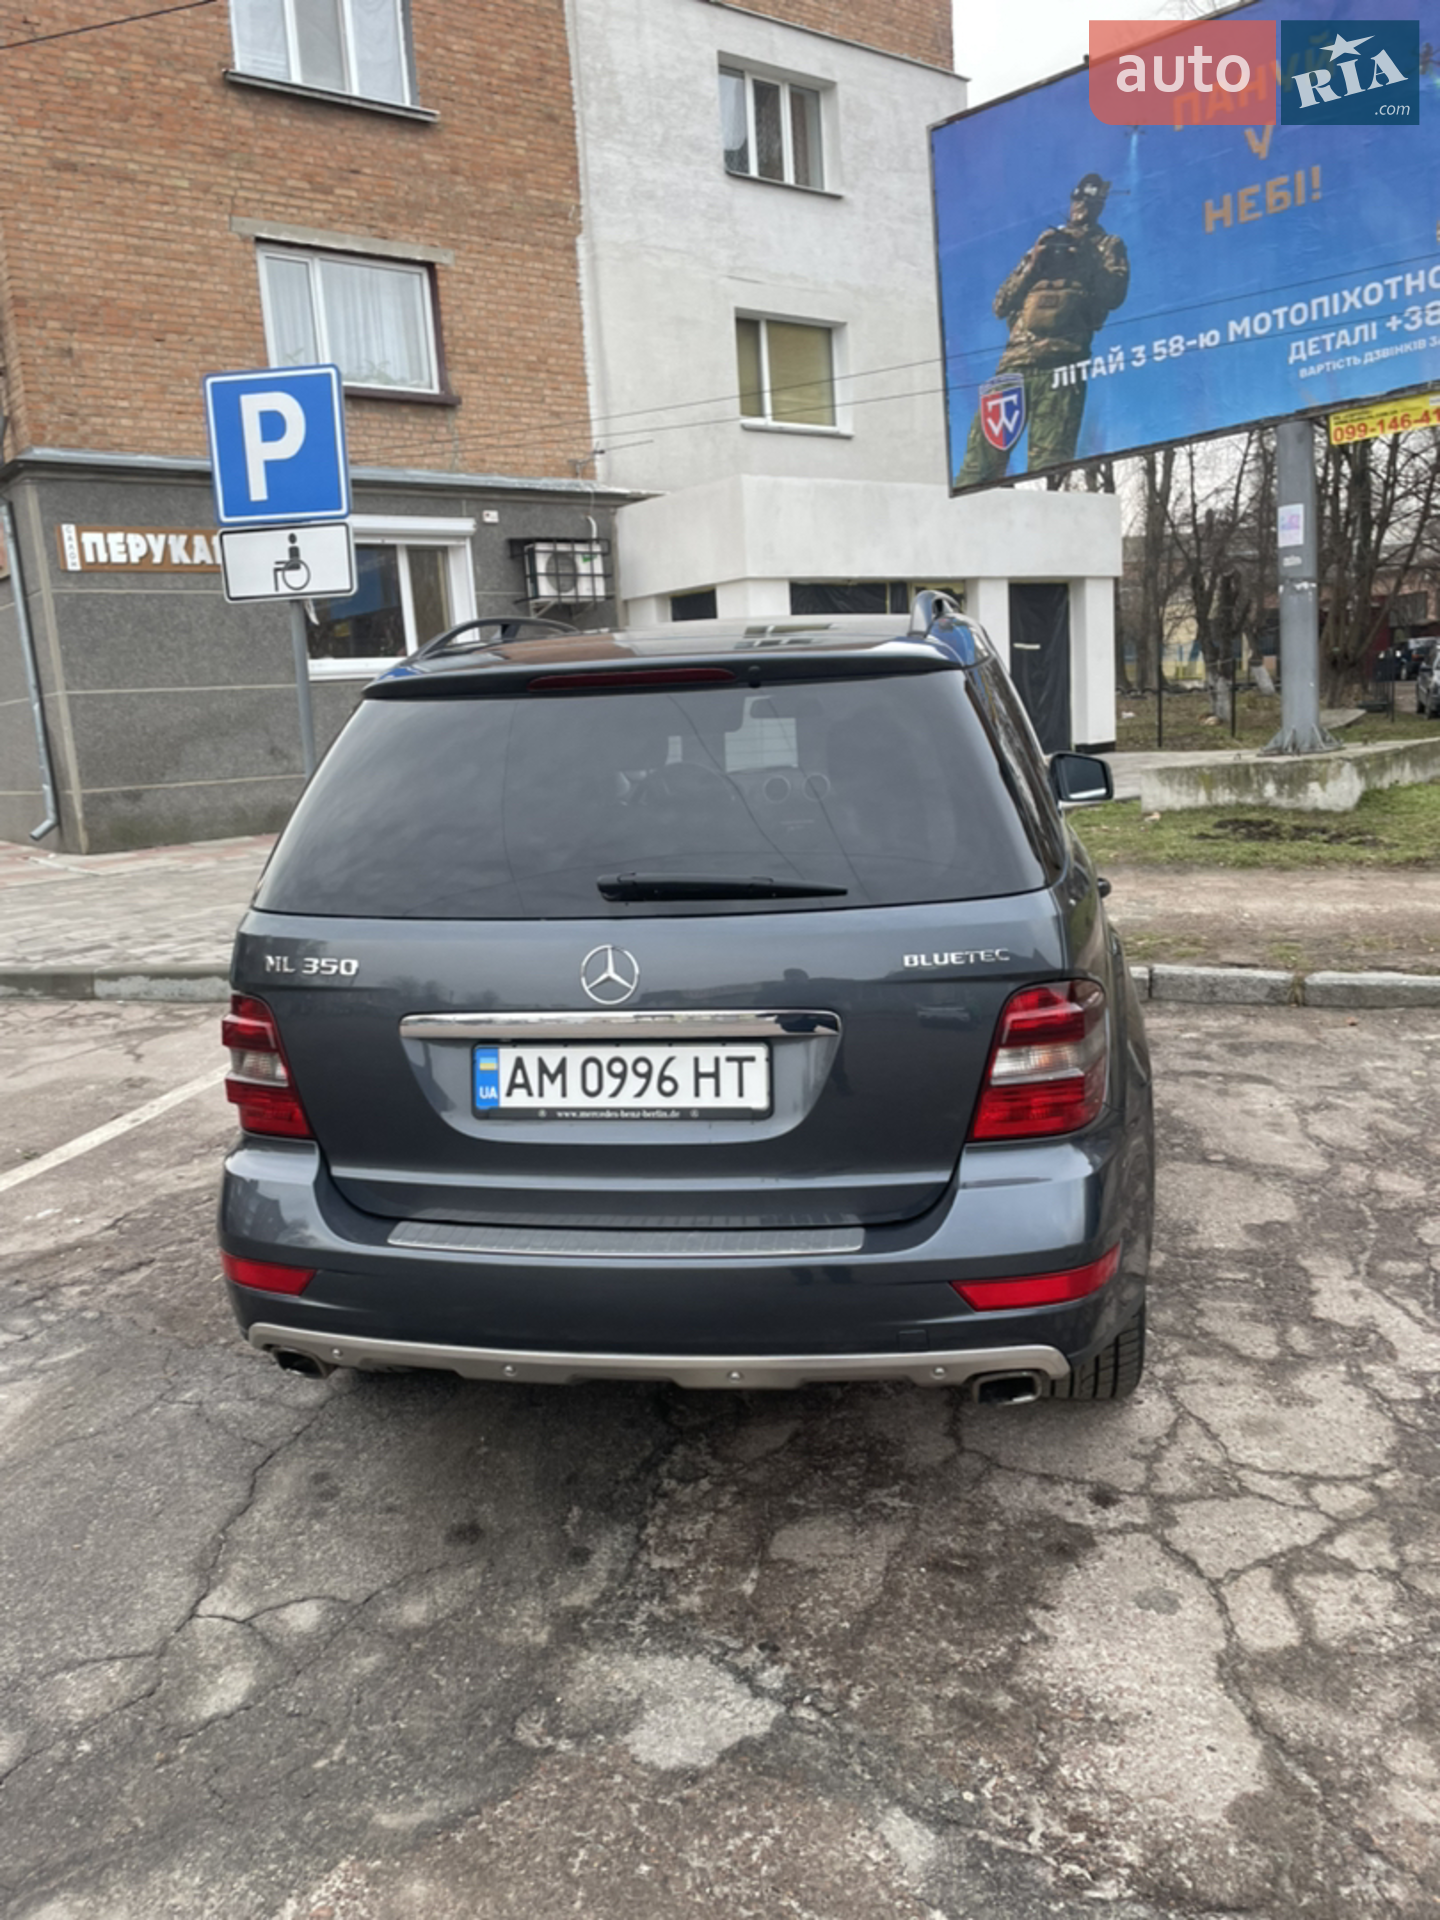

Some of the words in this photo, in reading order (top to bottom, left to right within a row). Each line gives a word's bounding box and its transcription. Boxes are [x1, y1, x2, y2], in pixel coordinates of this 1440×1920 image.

[1203, 164, 1322, 235] НЕБІ!
[1288, 321, 1378, 366] ДЕТАЛІ
[1051, 345, 1125, 390] ЛІТАЙ
[240, 391, 306, 501] P
[265, 956, 296, 972] ML
[302, 957, 359, 975] 350
[903, 948, 1010, 968] BLUETEC
[480, 1087, 498, 1099] UA
[505, 1056, 567, 1098] AM
[581, 1056, 679, 1098] 0996
[694, 1056, 756, 1098] HT
